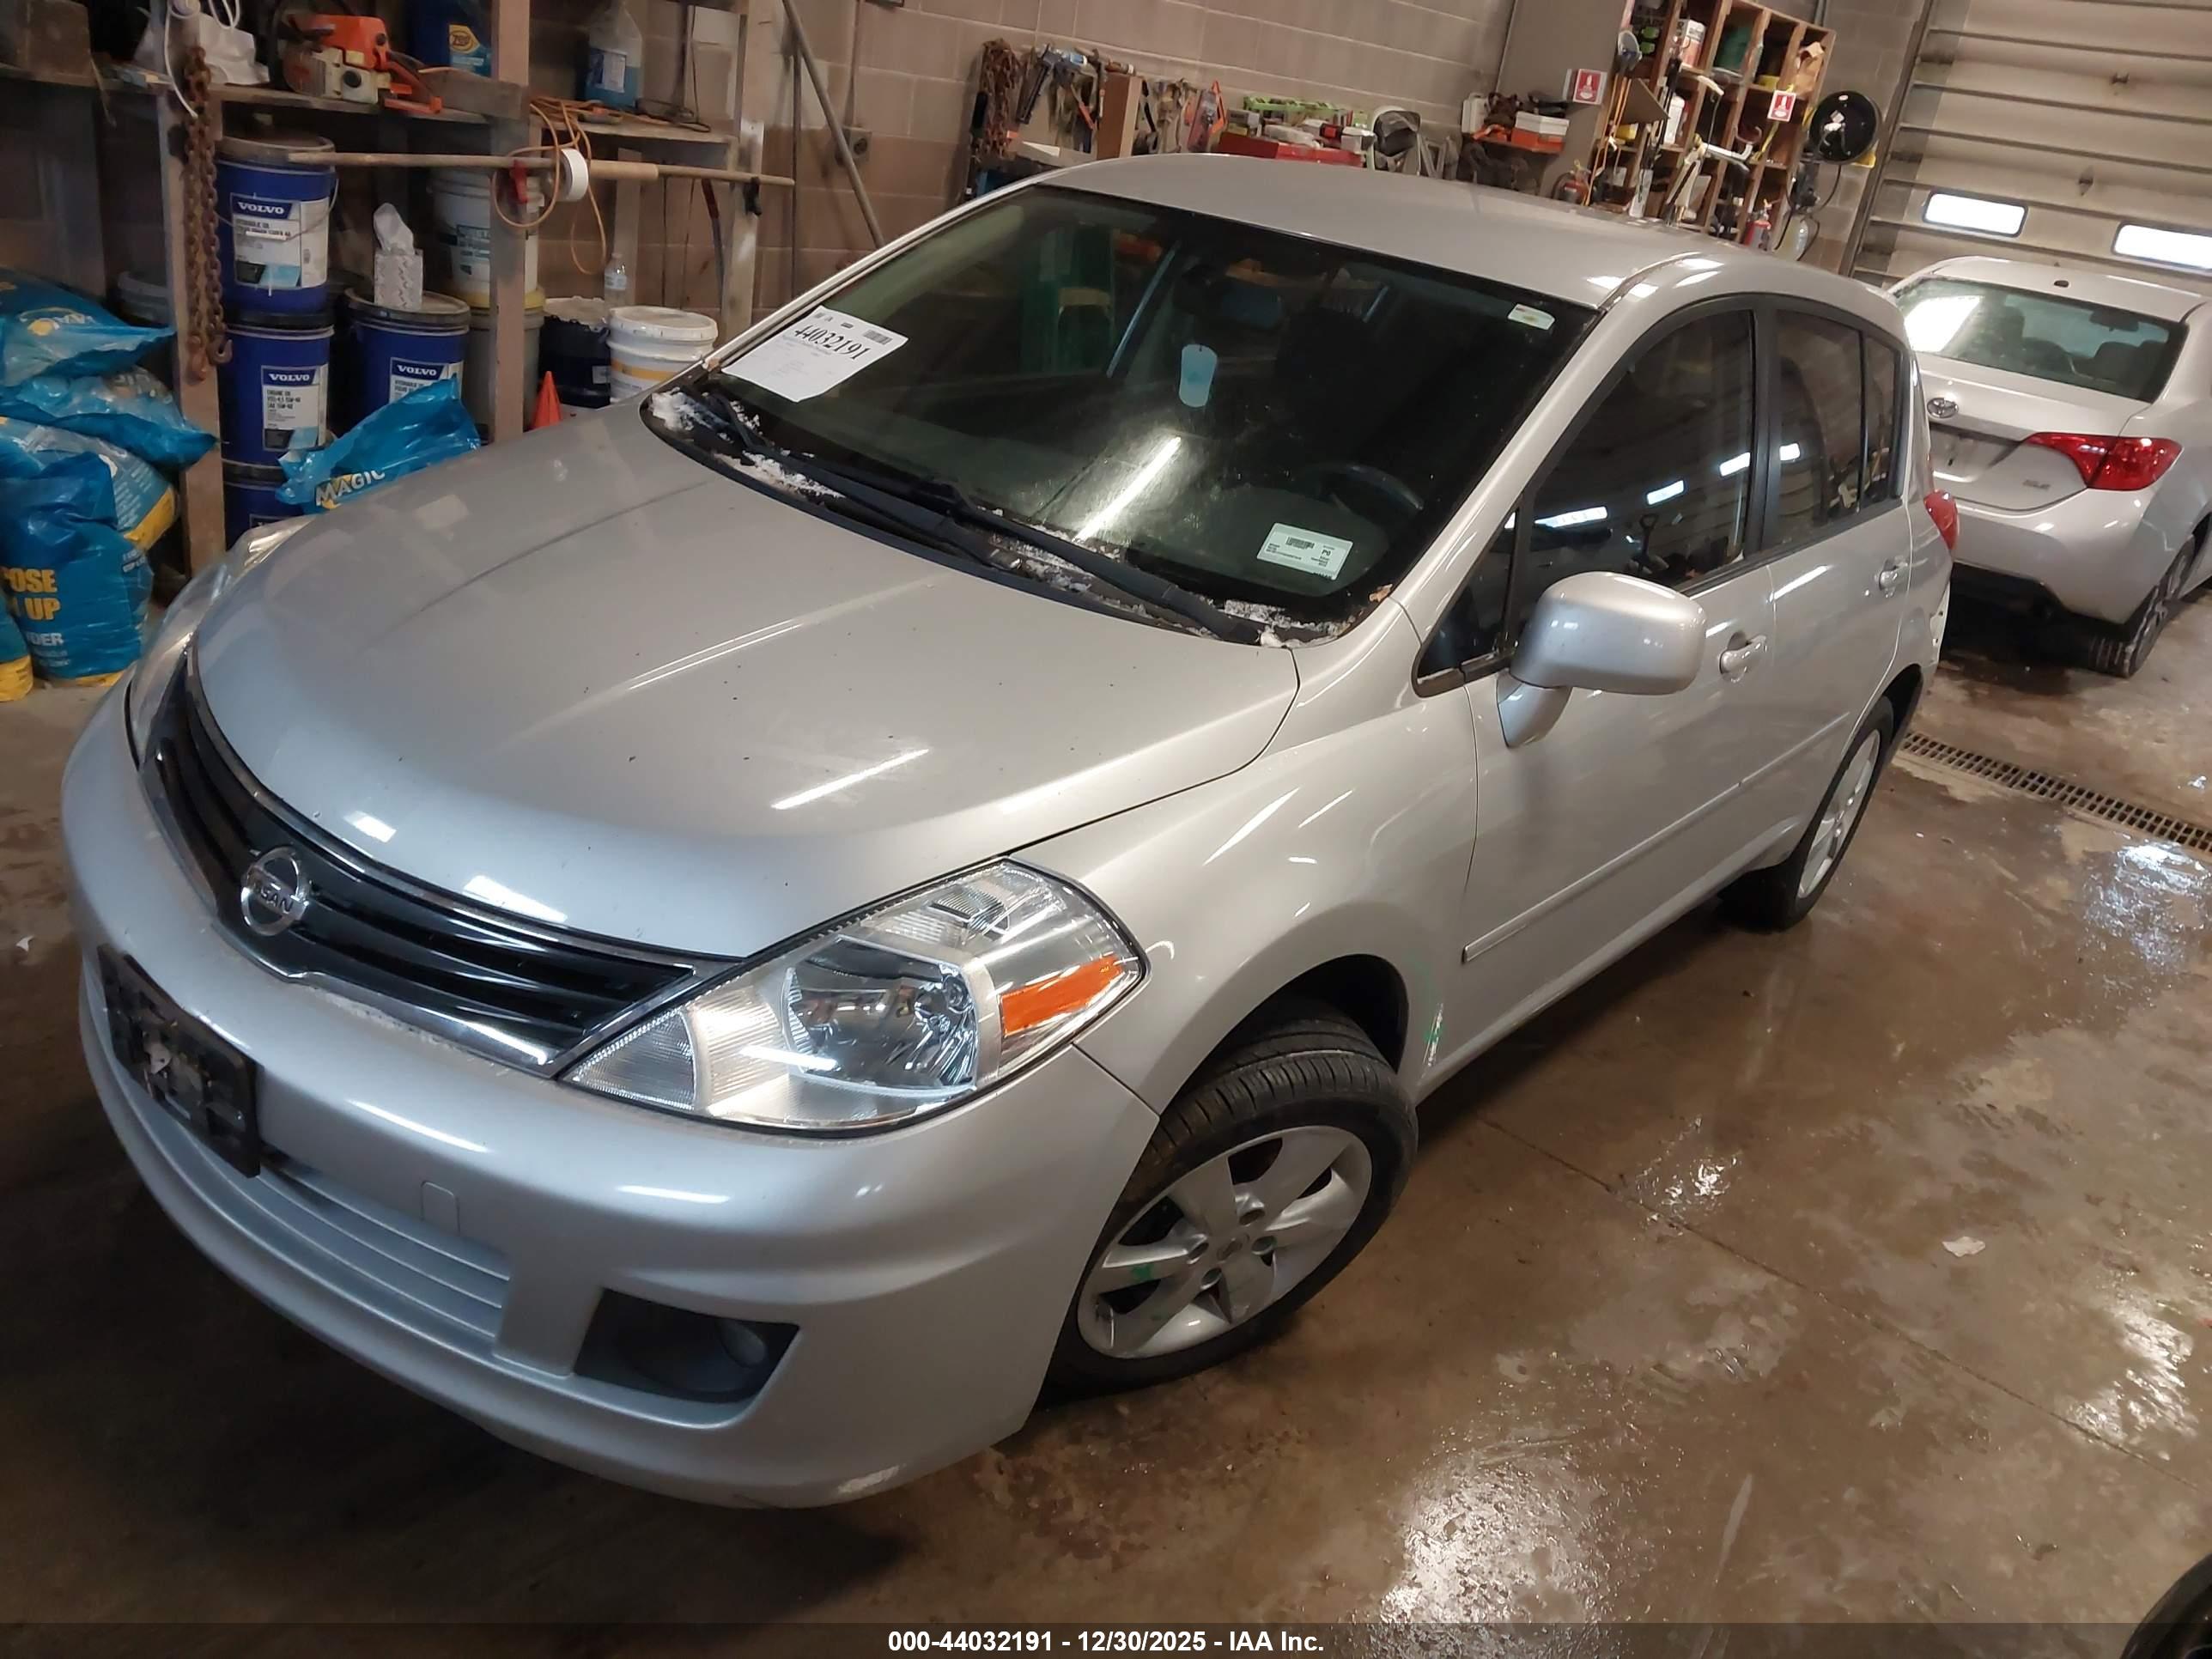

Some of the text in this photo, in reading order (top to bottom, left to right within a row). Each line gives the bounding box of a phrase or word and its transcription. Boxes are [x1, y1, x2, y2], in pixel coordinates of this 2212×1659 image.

[238, 202, 284, 215] VOLVO
[794, 325, 871, 361] 44032191
[398, 364, 437, 376] VOLVO
[315, 470, 386, 507] MAGIC
[25, 597, 61, 620] UP
